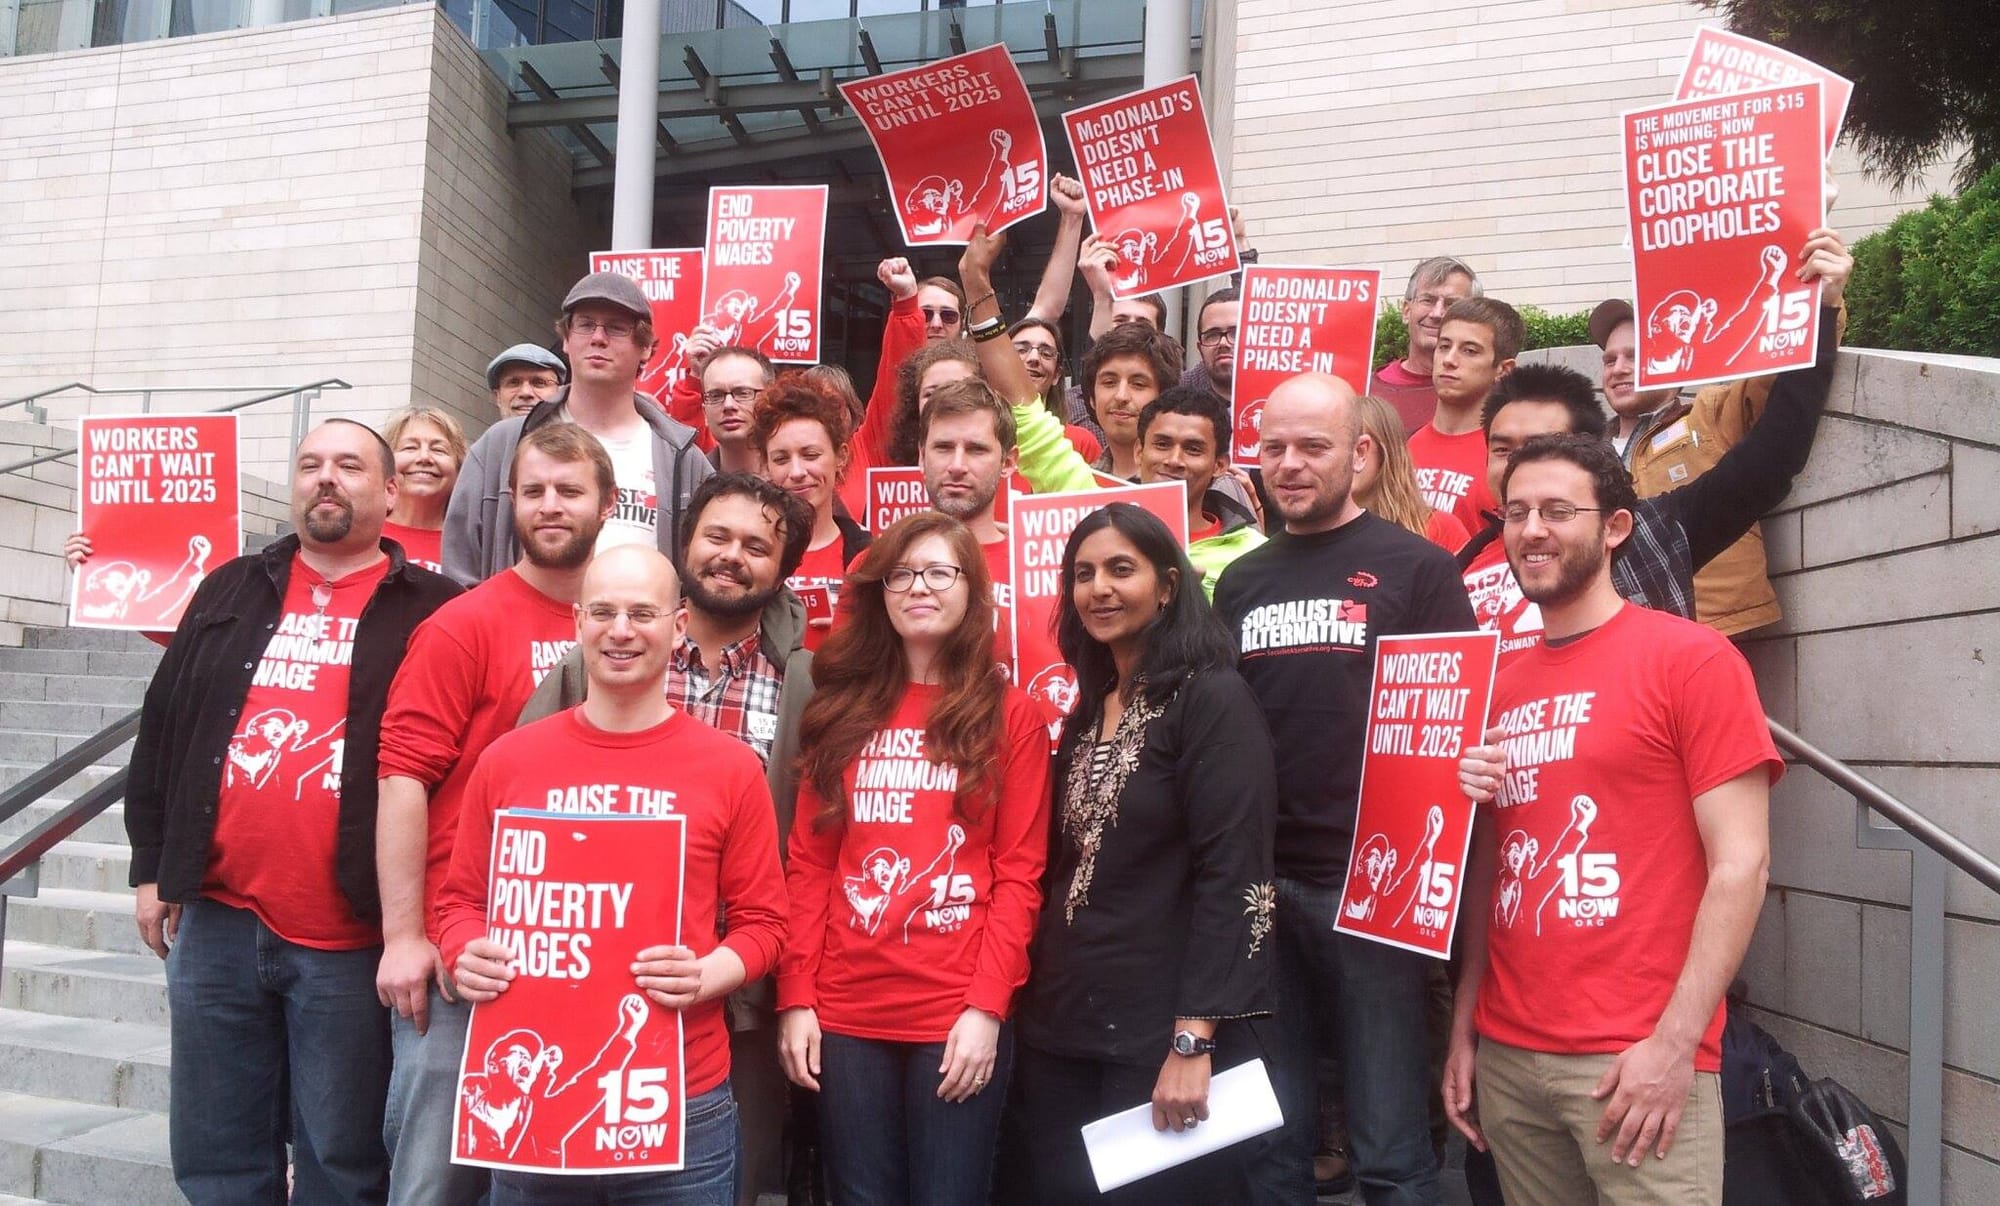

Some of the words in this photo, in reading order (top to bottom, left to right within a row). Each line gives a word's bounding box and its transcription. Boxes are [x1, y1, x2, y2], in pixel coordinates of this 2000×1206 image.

[855, 64, 969, 103] WORKERS
[866, 89, 930, 115] CAN'T
[935, 72, 993, 97] WAIT
[875, 103, 942, 131] UNTIL
[945, 85, 1001, 113] 2025
[1076, 90, 1192, 142] McDONALD'S
[1634, 117, 1658, 134] THE
[1663, 102, 1739, 130] MOVEMENT
[1743, 96, 1772, 114] FOR
[1776, 92, 1804, 112] $15
[1082, 124, 1160, 166] DOESN'T
[1635, 136, 1648, 150] IS
[1722, 117, 1755, 136] NOW
[1089, 156, 1138, 188] NEED
[1144, 151, 1156, 173] A
[1637, 143, 1713, 184] CLOSE
[1722, 134, 1775, 169] THE
[1000, 160, 1040, 199] 15
[1094, 167, 1184, 212] PHASE-IN
[1639, 166, 1785, 218] CORPORATE
[719, 194, 752, 218] END
[1002, 186, 1039, 213] NOW
[716, 218, 796, 241] POVERTY
[1188, 218, 1228, 252] 15
[1641, 201, 1781, 252] LOOPHOLES
[649, 257, 682, 278] THE
[715, 242, 773, 266] WAGES
[1194, 246, 1230, 266] NOW
[1252, 278, 1370, 302] McDONALD'S
[774, 309, 812, 338] 15
[1248, 302, 1328, 324] DOESN'T
[1762, 290, 1811, 333] 15
[774, 338, 810, 352] NOW
[1246, 325, 1292, 347] NEED
[1299, 326, 1311, 348] A
[1759, 328, 1808, 352] NOW
[1243, 350, 1334, 374] PHASE-IN
[90, 426, 198, 452] WORKERS
[90, 454, 154, 478] CAN'T
[160, 452, 215, 476] WAIT
[90, 480, 154, 504] UNTIL
[161, 479, 216, 503] 2025
[1439, 470, 1474, 497] THE
[276, 612, 334, 640] AISE
[1242, 598, 1342, 632] SOCIALIST
[1241, 620, 1367, 654] ALTERNATIVE
[531, 641, 578, 668] RAIS
[1382, 652, 1462, 684] WORKERS
[1377, 688, 1423, 720] CAN'T
[1426, 688, 1470, 720] WAIT
[1552, 692, 1596, 726] THE
[861, 728, 926, 758] RAISE
[1372, 724, 1414, 756] UNTIL
[1418, 724, 1464, 758] 2025
[856, 760, 958, 792] MINIMUM
[546, 784, 620, 814] RAISE
[626, 786, 677, 814] THE
[854, 792, 914, 824] WAGE
[498, 828, 546, 876] END
[1419, 860, 1456, 908] 15
[1557, 853, 1620, 896] 15
[492, 878, 634, 929] POVERTY
[930, 874, 976, 908] 15
[925, 904, 970, 928] NOW
[1413, 904, 1448, 930] NOW
[1559, 897, 1620, 918] NOW
[597, 1067, 670, 1124] 15
[595, 1122, 668, 1151] NOW
[614, 1150, 648, 1161] ORG
